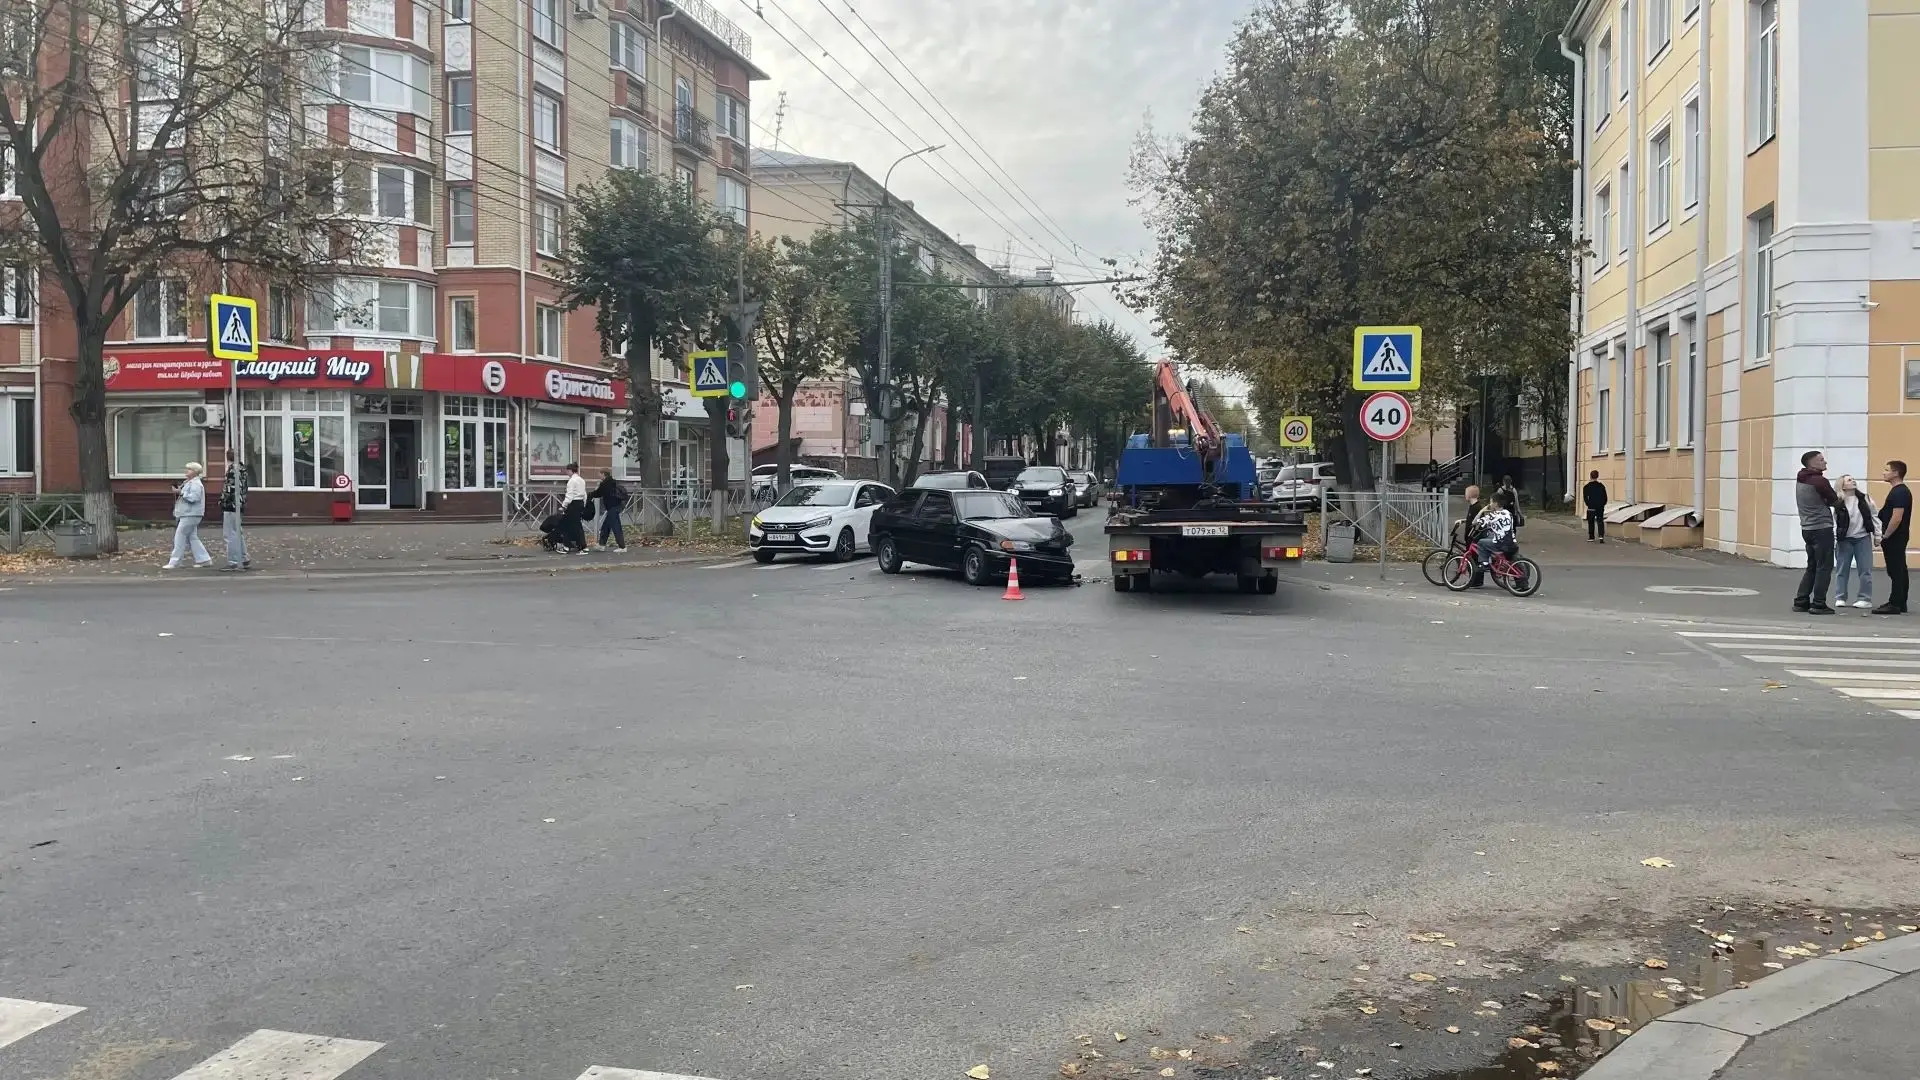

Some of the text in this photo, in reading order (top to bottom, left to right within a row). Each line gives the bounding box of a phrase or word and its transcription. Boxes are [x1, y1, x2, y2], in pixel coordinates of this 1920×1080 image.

[235, 356, 370, 381] Сладкий Мир
[549, 371, 615, 400] Бристоль
[1371, 408, 1401, 426] 40
[1288, 425, 1304, 437] 40
